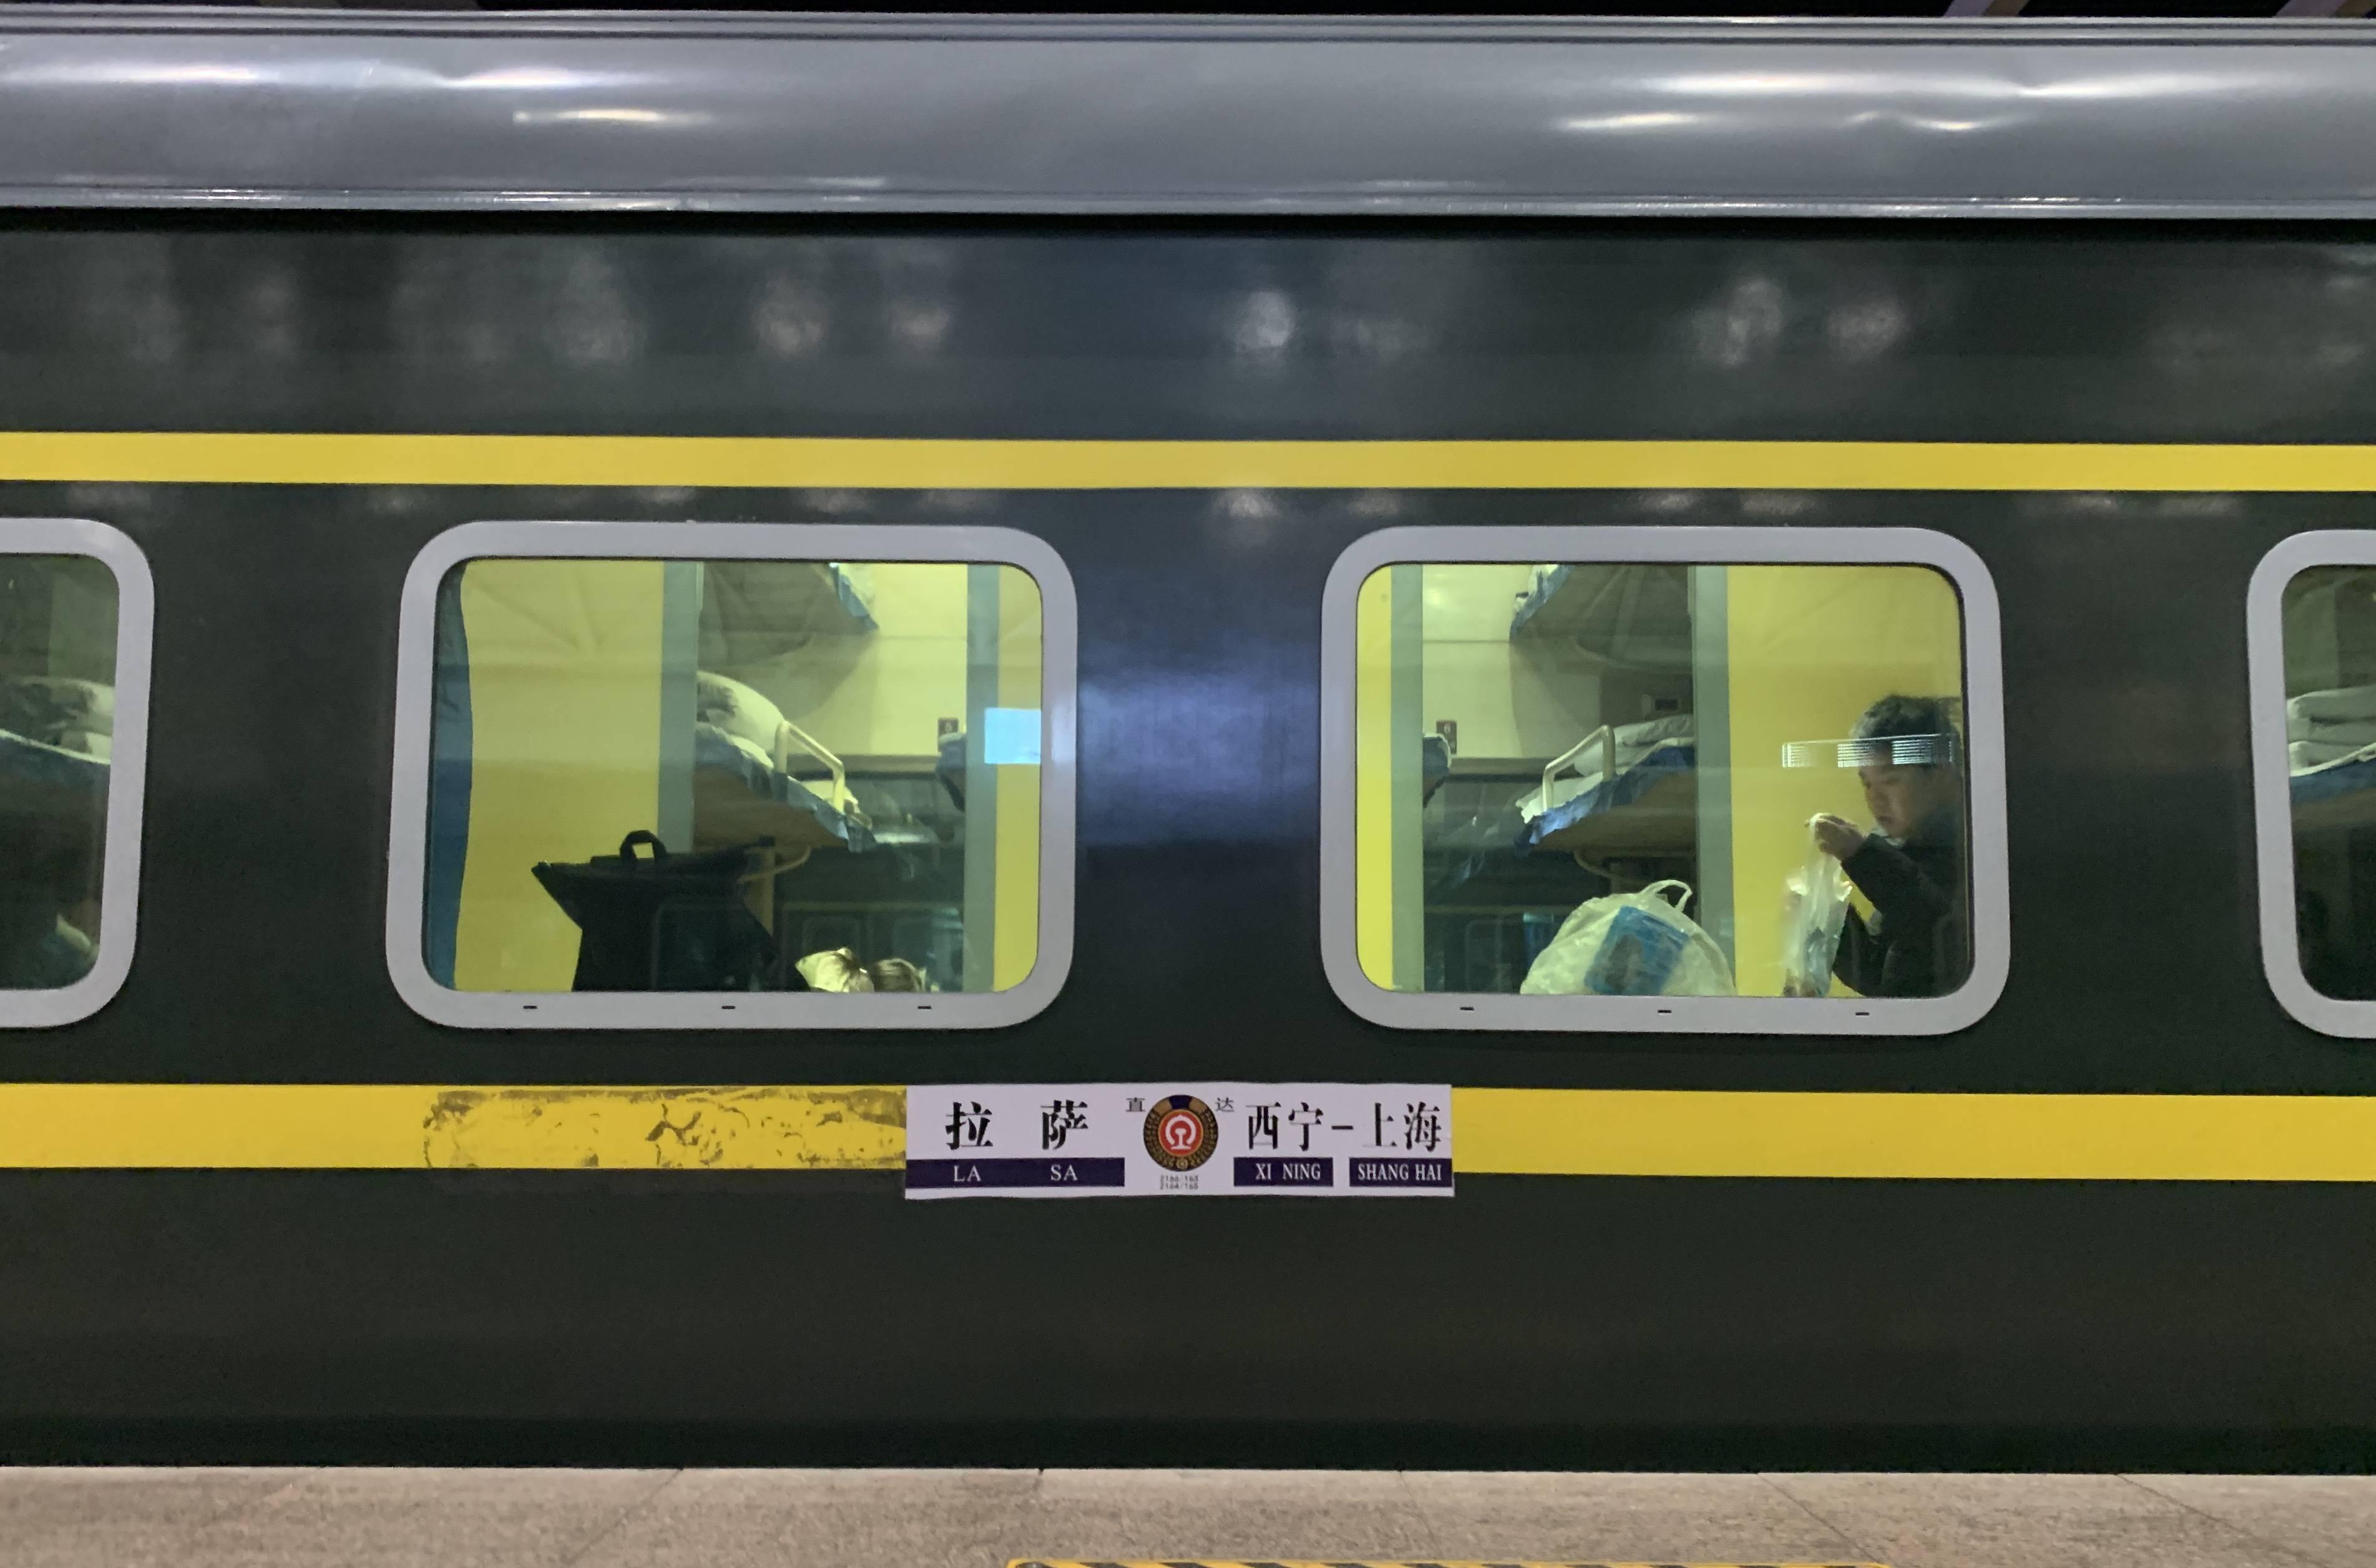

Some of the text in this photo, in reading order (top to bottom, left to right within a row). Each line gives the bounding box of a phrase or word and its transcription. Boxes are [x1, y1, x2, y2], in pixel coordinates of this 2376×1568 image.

[1125, 1096, 1235, 1113] 直 达
[945, 1099, 1089, 1151] 拉萨
[954, 1164, 1078, 1182] LA SA
[1255, 1163, 1321, 1181] XI NING
[1357, 1163, 1442, 1181] SHANG HAI
